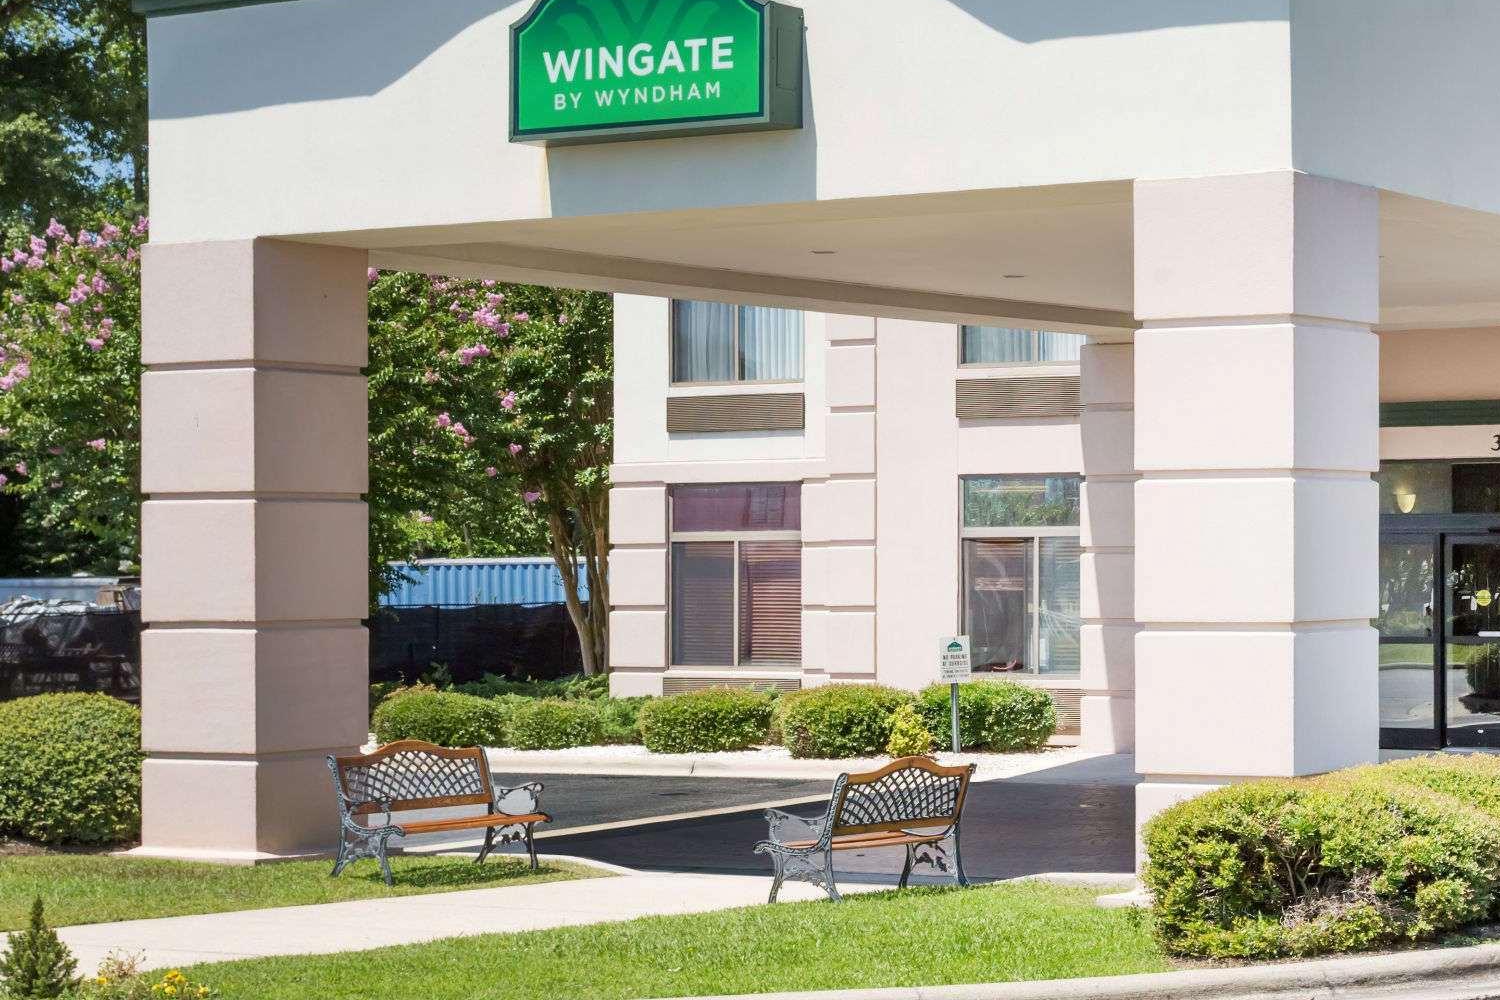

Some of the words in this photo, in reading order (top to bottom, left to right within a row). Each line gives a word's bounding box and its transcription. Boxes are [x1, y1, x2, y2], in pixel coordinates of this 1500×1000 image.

[542, 35, 734, 83] WINGATE
[554, 92, 583, 111] BY
[595, 81, 721, 107] WYNDHAM
